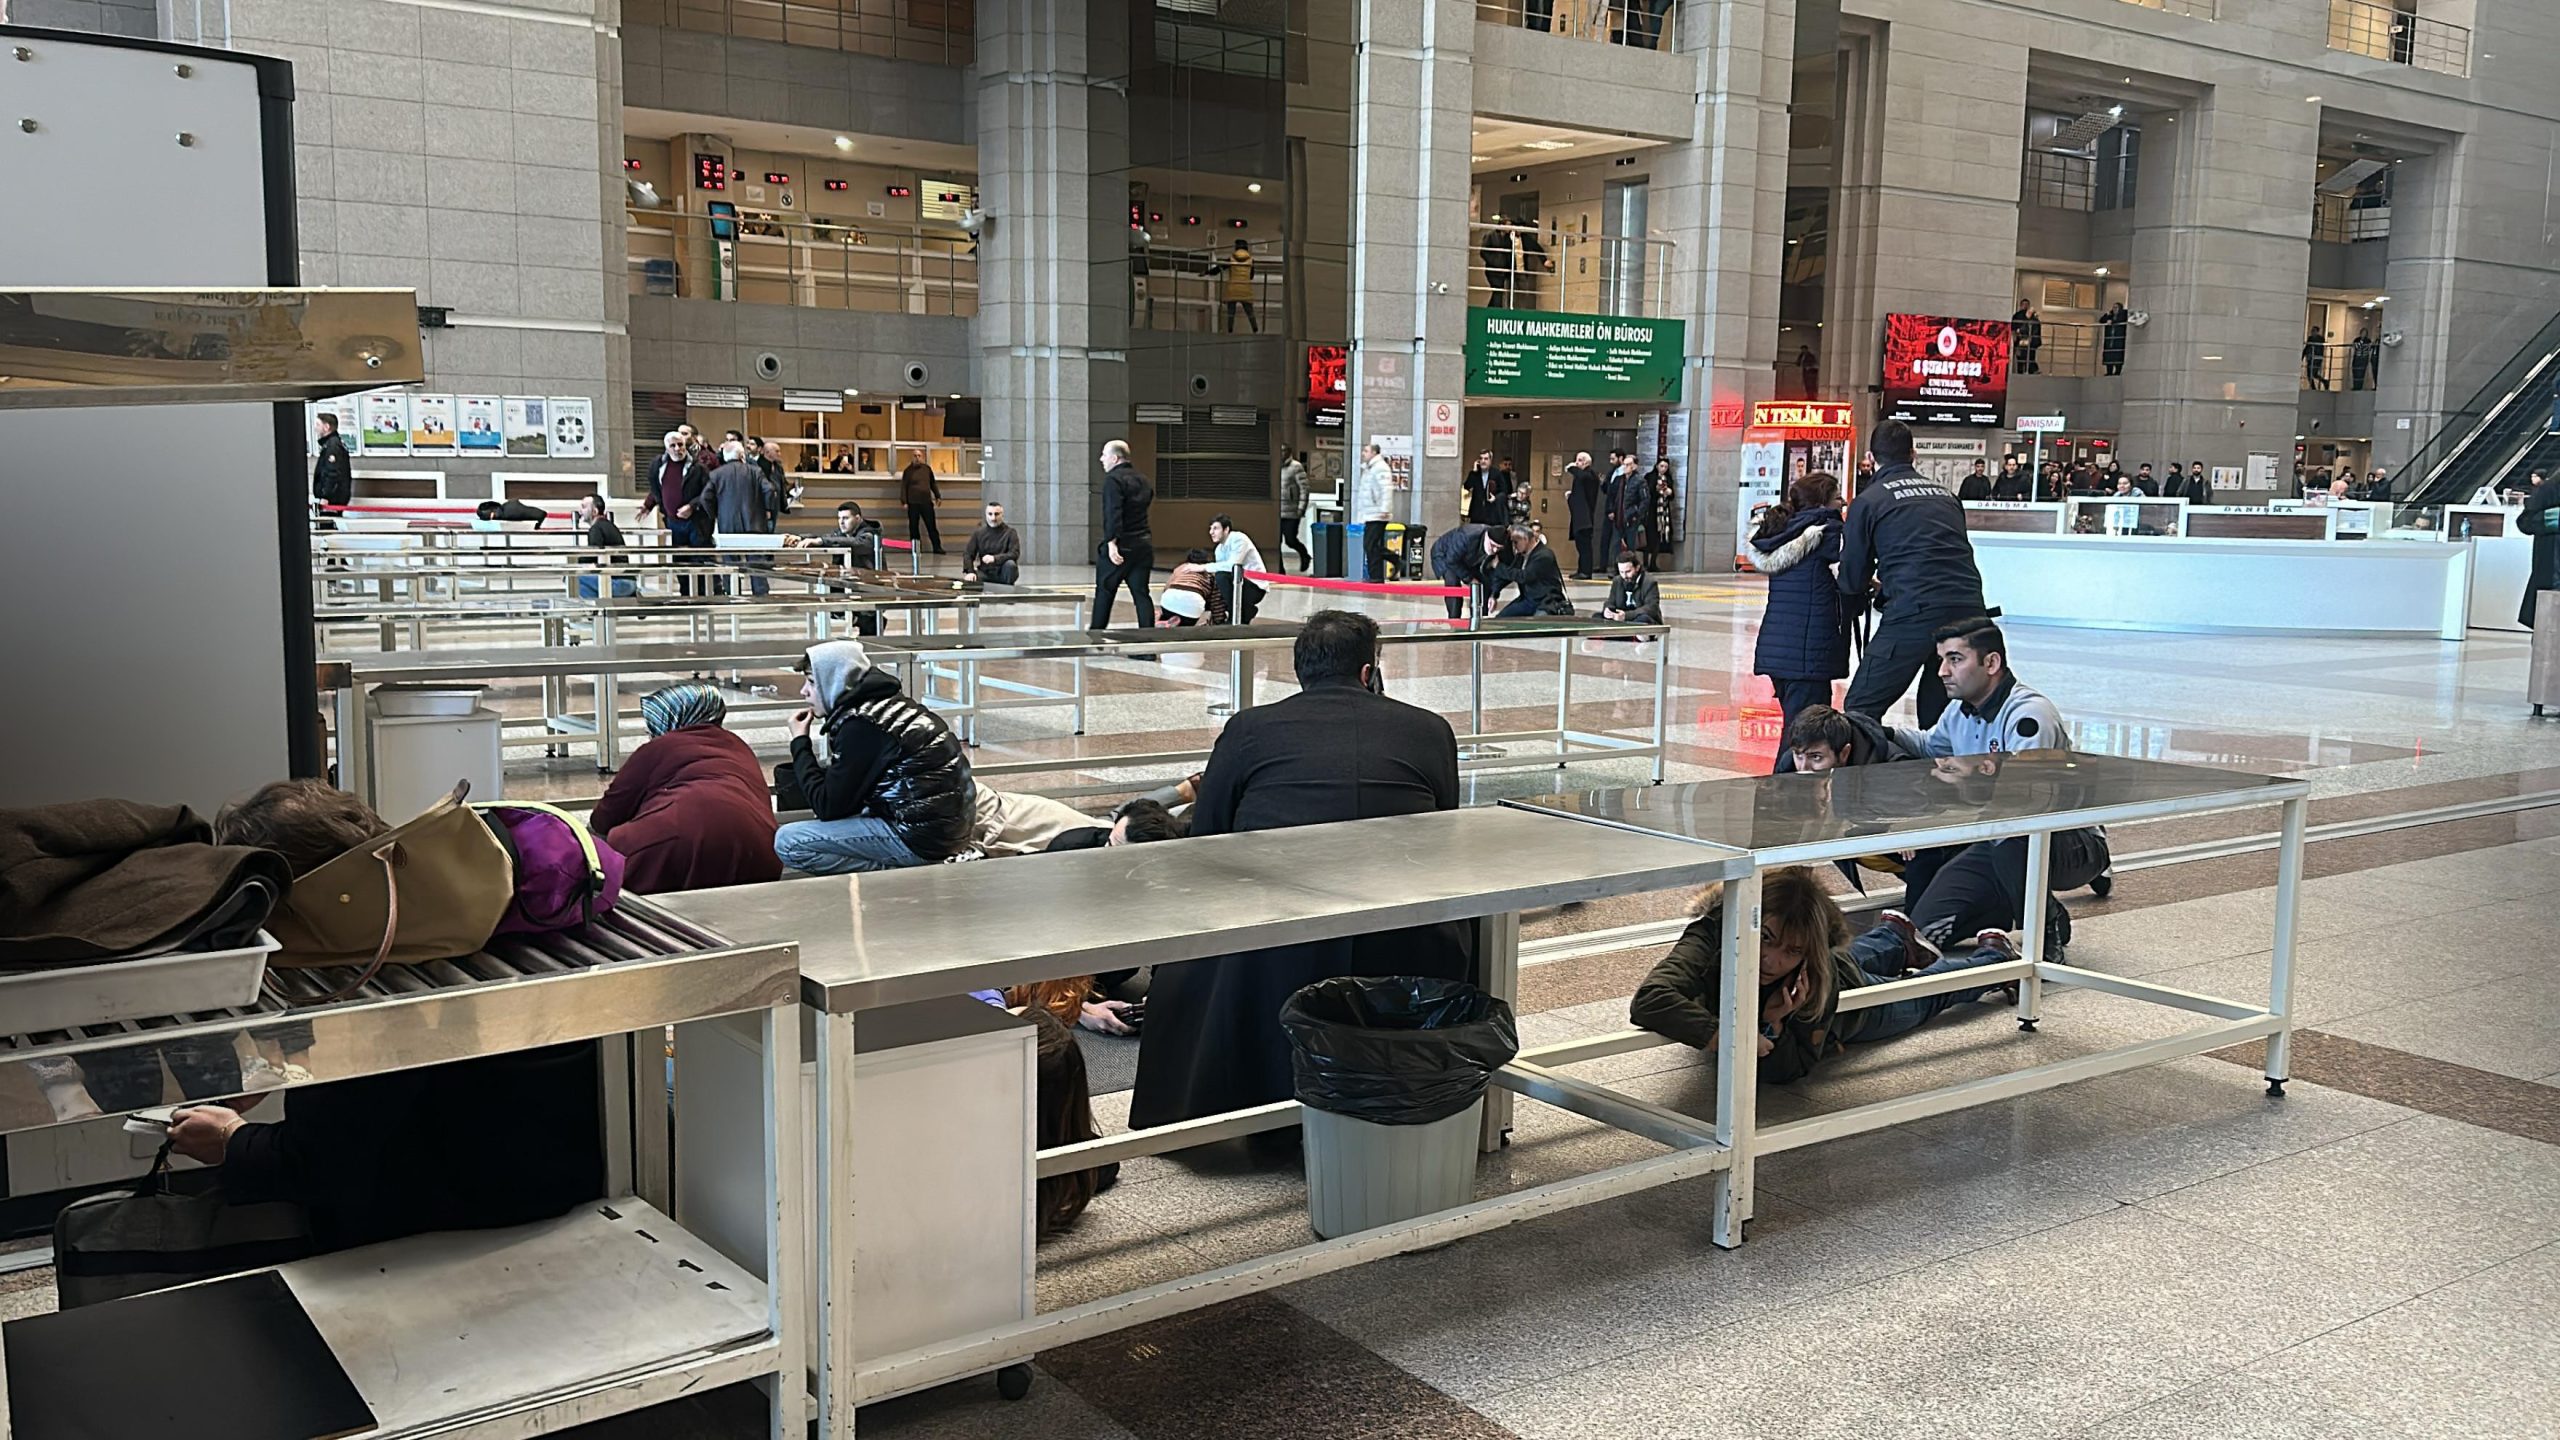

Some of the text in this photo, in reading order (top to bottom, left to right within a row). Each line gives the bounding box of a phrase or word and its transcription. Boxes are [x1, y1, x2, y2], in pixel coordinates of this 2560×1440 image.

[1487, 318, 1653, 343] HUKUK MAHKEMELERİ ÖN BÜROSU
[1922, 360, 1956, 377] ŞUBAT
[1770, 404, 1825, 425] TESLİM
[2018, 418, 2060, 429] DANIŞMA
[1792, 427, 1852, 440] FOTOSHOP
